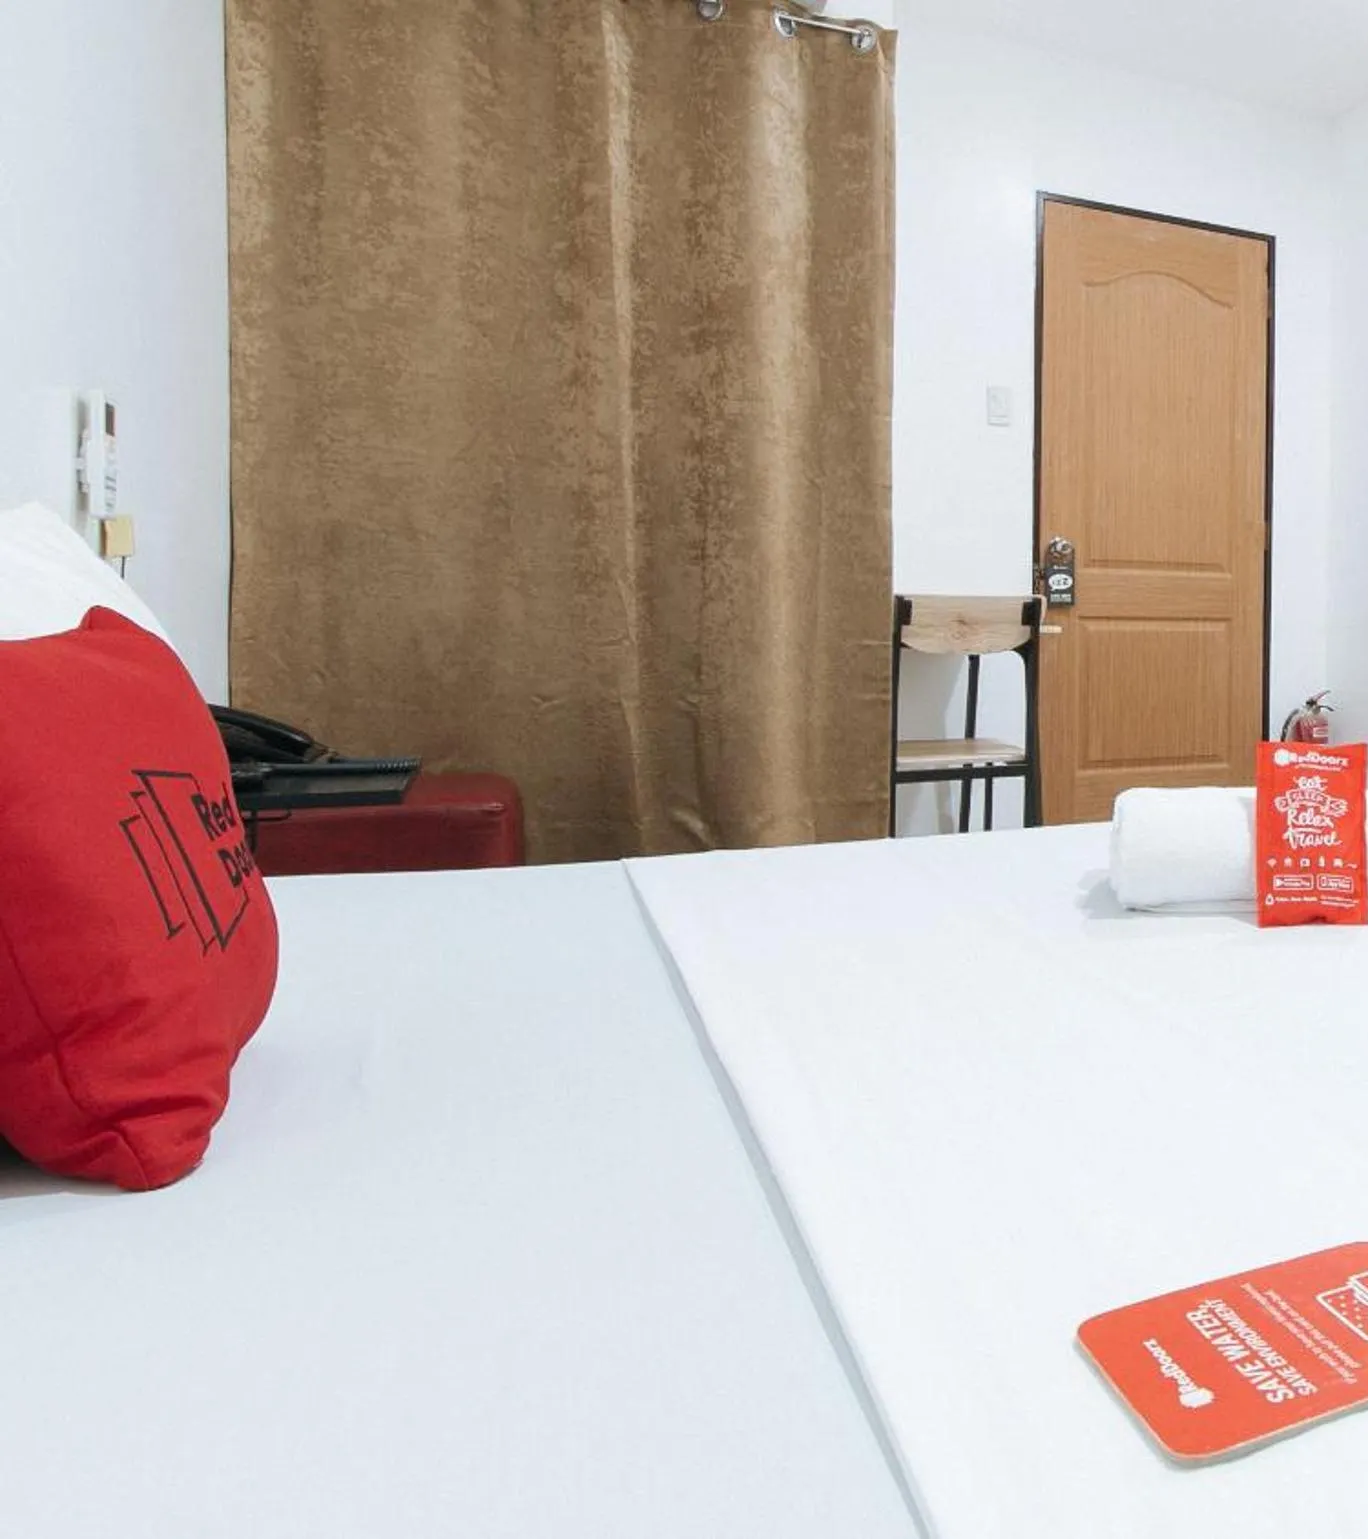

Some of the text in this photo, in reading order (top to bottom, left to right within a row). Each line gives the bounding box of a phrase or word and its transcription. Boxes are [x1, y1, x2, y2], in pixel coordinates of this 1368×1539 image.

[190, 780, 237, 843] Red
[1206, 1298, 1288, 1369] ENVIRONMENT
[1234, 1359, 1296, 1404] SAVE
[1275, 1365, 1319, 1397] SAVE
